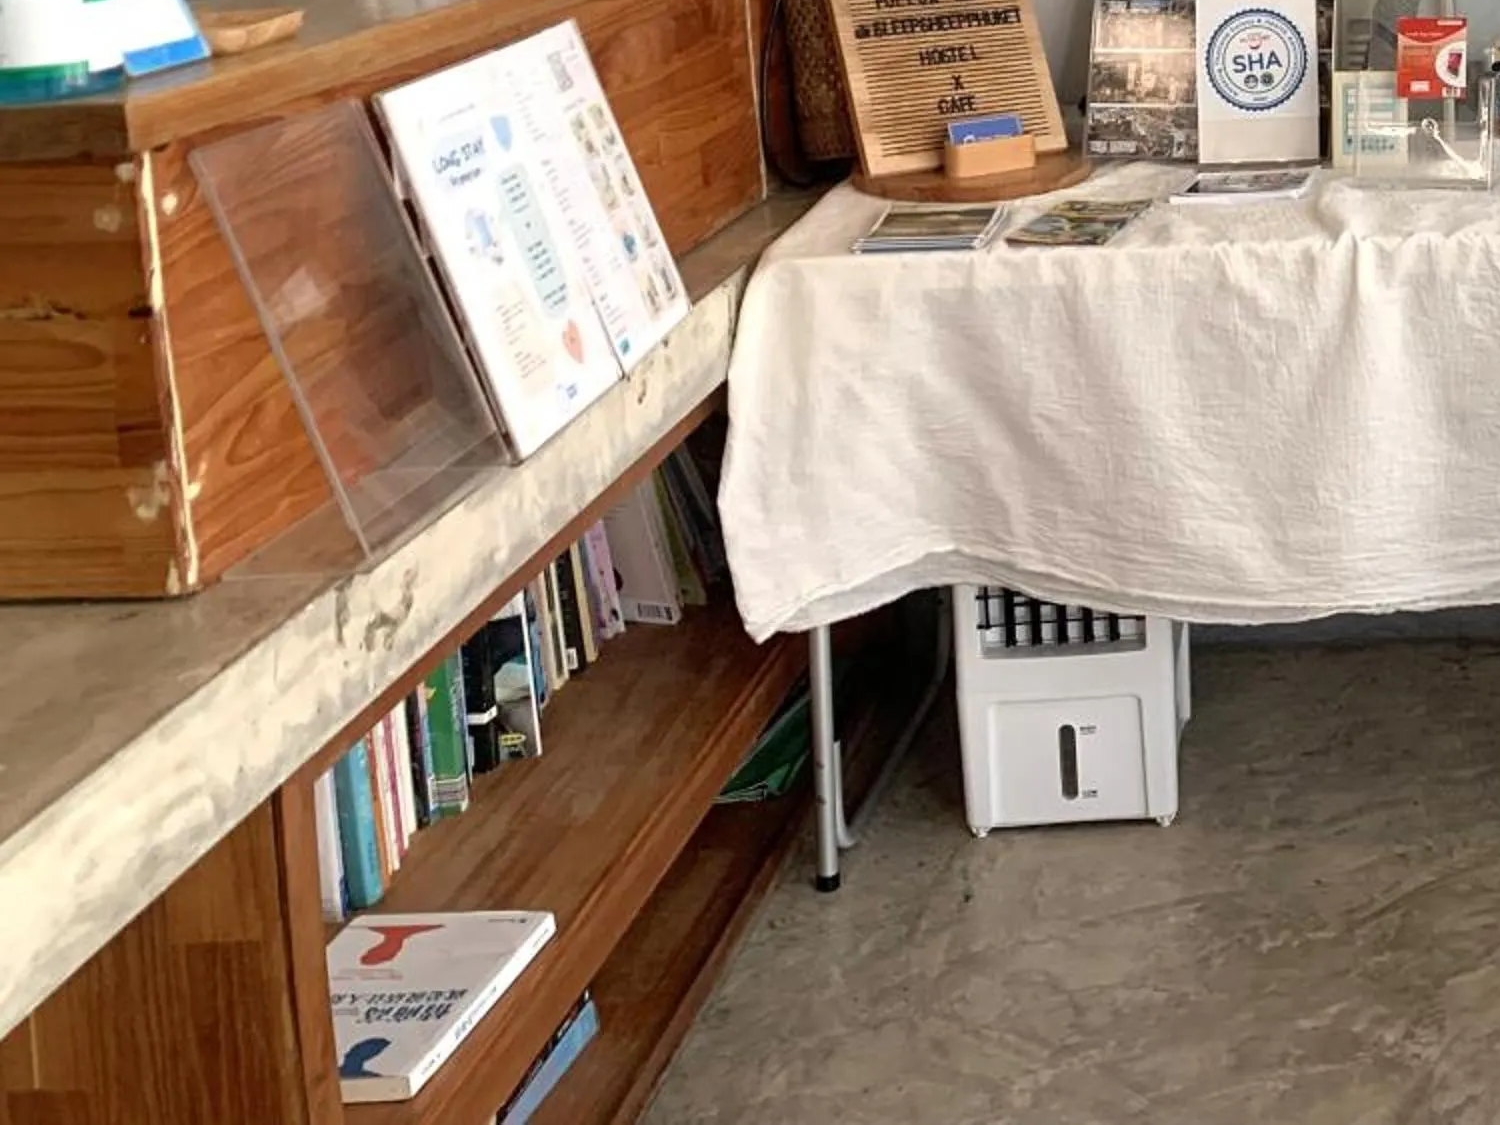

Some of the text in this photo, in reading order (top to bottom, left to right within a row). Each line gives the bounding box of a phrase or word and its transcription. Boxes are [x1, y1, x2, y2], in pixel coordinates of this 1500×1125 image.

[917, 43, 979, 67] HOSTEL
[1232, 49, 1283, 73] SHA
[937, 94, 976, 115] CAFE
